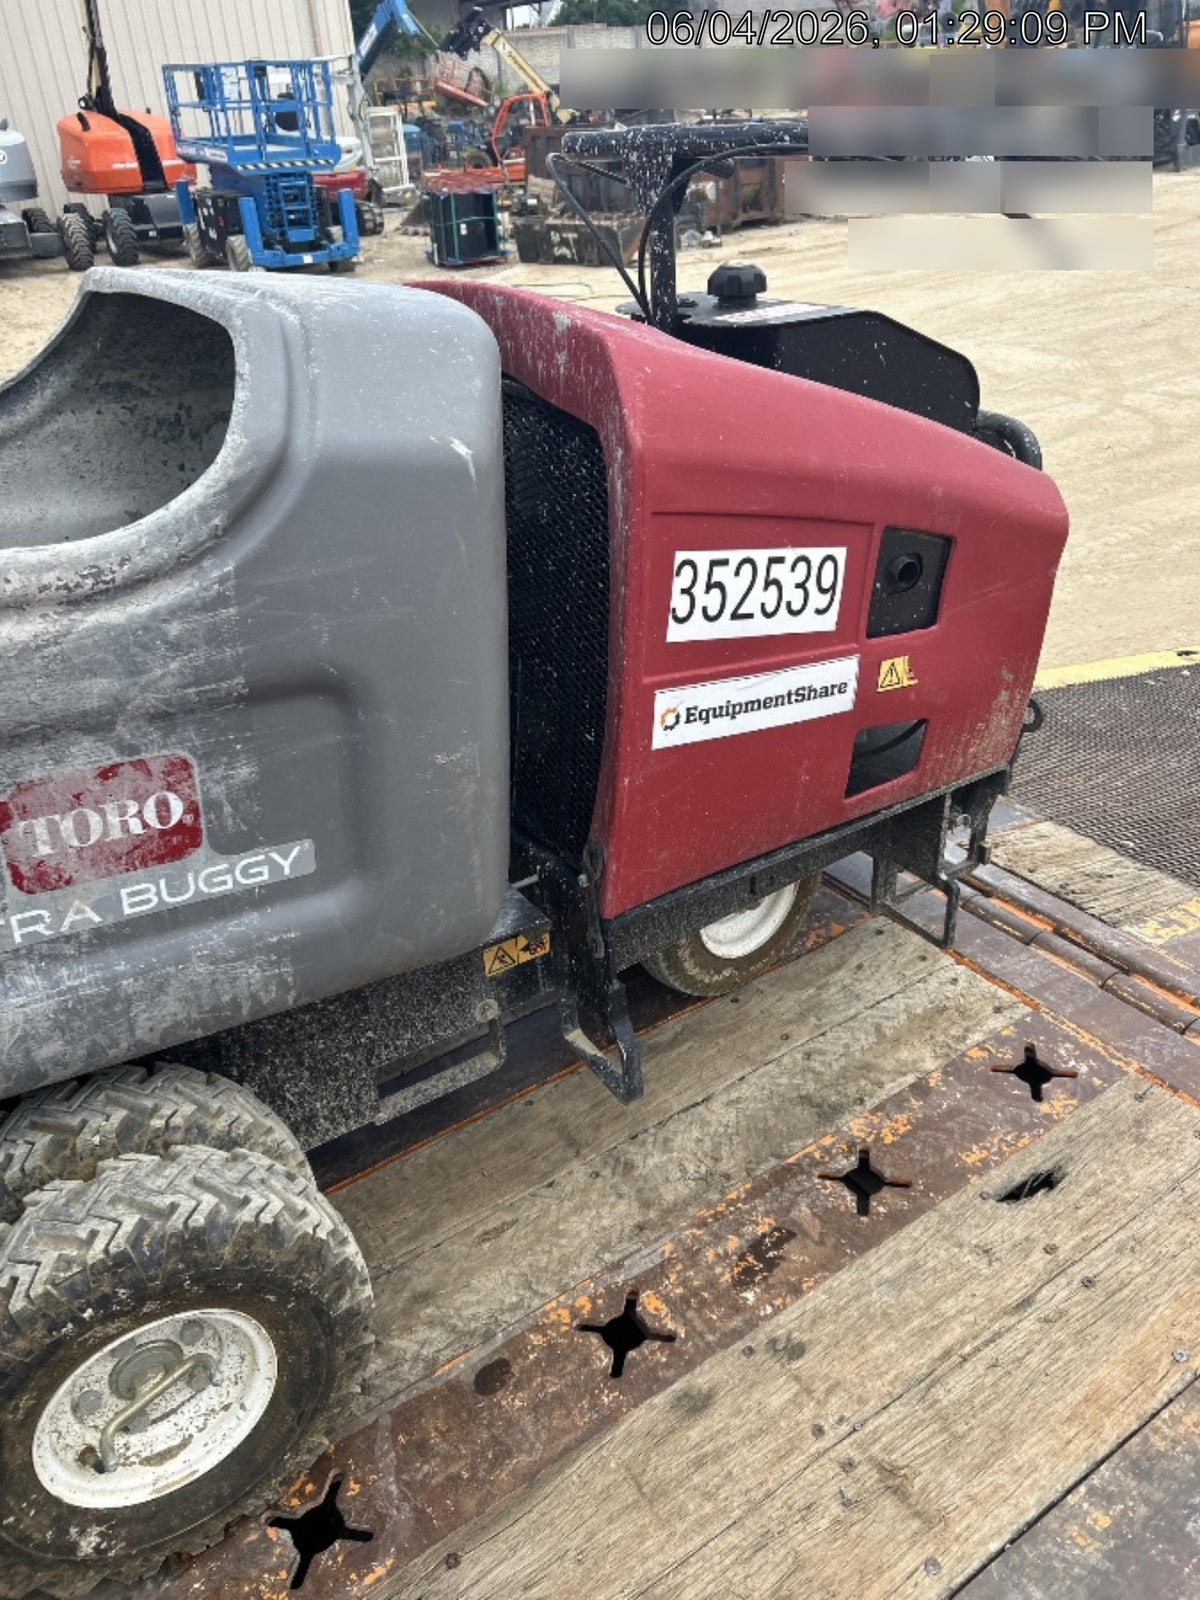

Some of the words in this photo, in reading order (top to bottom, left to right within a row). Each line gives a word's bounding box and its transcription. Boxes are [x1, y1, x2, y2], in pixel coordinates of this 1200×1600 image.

[671, 554, 839, 624] 352539
[684, 681, 848, 725] EquipmentShare
[18, 790, 184, 858] TORO
[0, 900, 103, 944] RA
[120, 846, 302, 915] BUGGY
